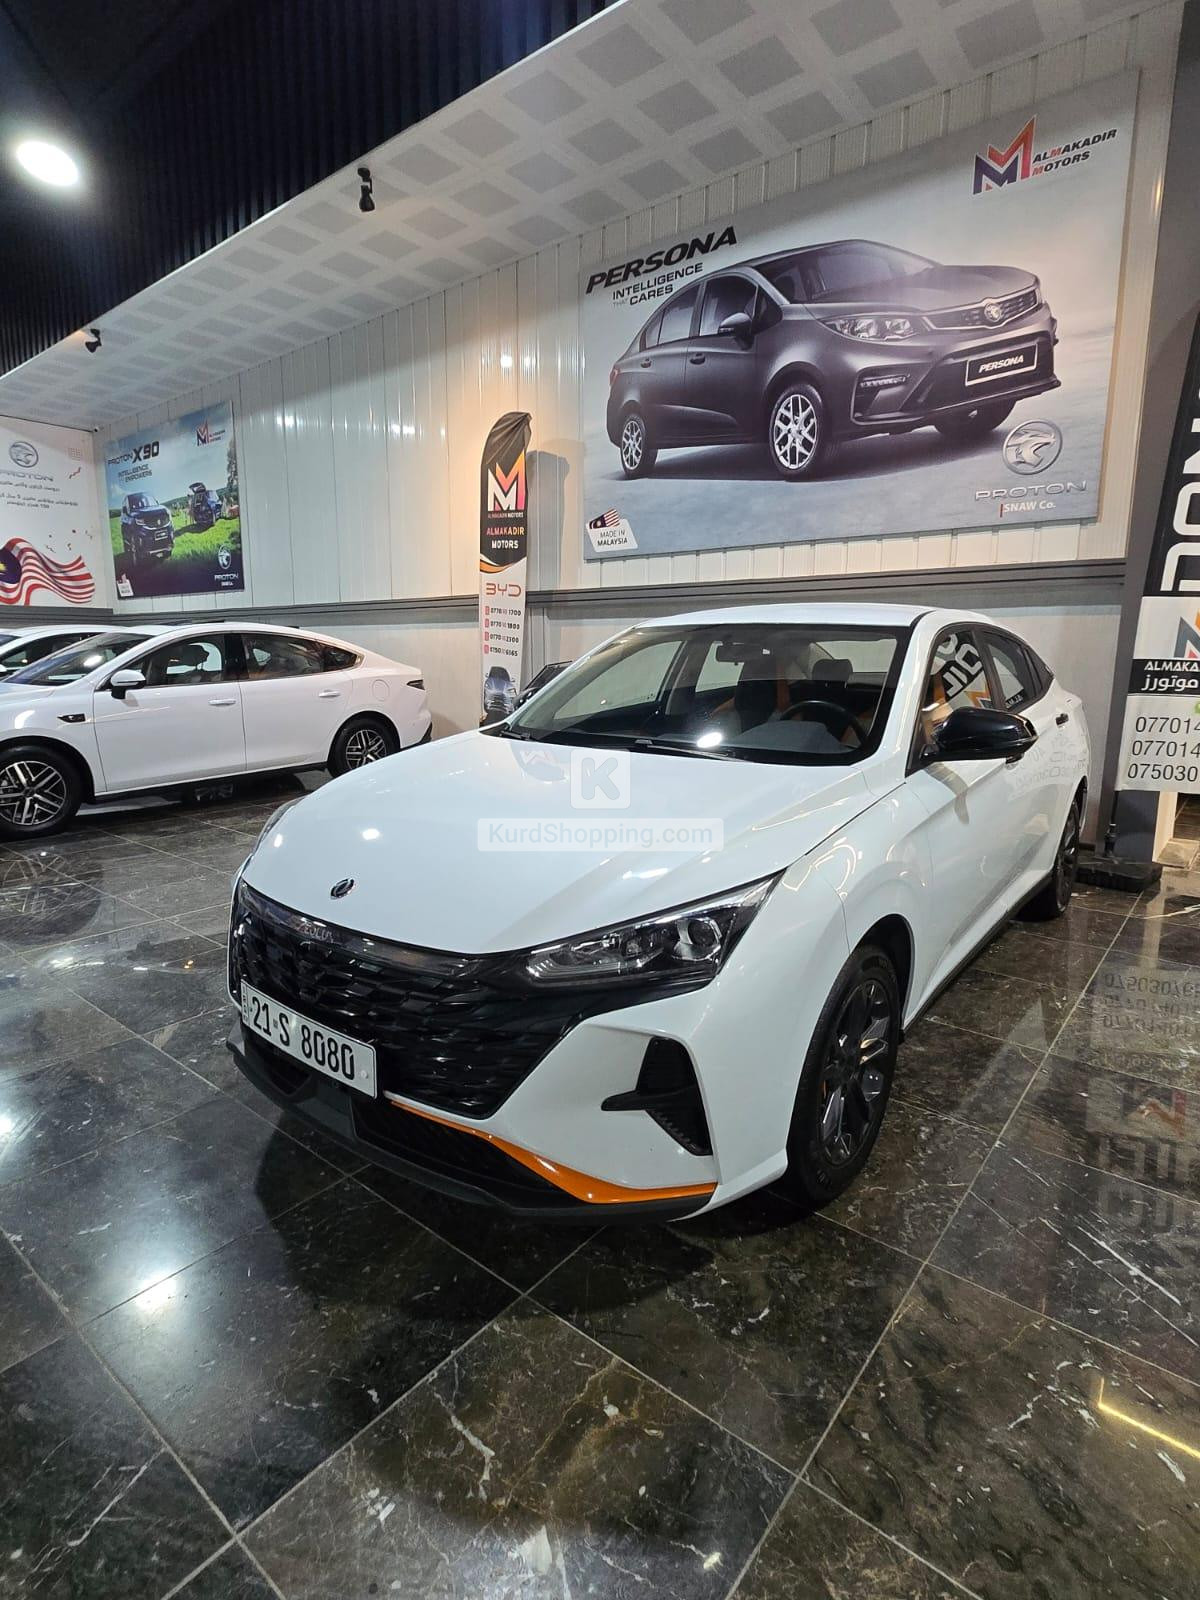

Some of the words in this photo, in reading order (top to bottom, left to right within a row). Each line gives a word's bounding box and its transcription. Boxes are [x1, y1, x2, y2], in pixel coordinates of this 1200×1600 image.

[1033, 129, 1118, 164] ALMAKADIR
[1032, 151, 1091, 176] MOTORS
[585, 226, 737, 295] PERSONA
[612, 262, 704, 300] INTELLIGENCE
[629, 284, 674, 306] CARES
[979, 354, 1025, 374] PERSONA
[132, 440, 160, 464] X90
[975, 480, 1088, 502] PROTON
[1003, 501, 1037, 513] SNAW
[1039, 500, 1056, 510] Co.
[486, 526, 525, 537] ALMAKADIR
[600, 530, 617, 538] MADE
[618, 529, 626, 537] IN
[491, 539, 519, 549] MOTORS
[597, 537, 628, 546] MALAYSIA
[486, 582, 522, 598] BYD
[1144, 660, 1200, 672] ALMAKA
[1141, 674, 1199, 692] موتورز
[1131, 740, 1200, 758] 077014
[1127, 763, 1198, 782] 075030
[252, 996, 272, 1037] 21
[278, 1012, 290, 1046] S
[301, 1024, 355, 1080] 8080
